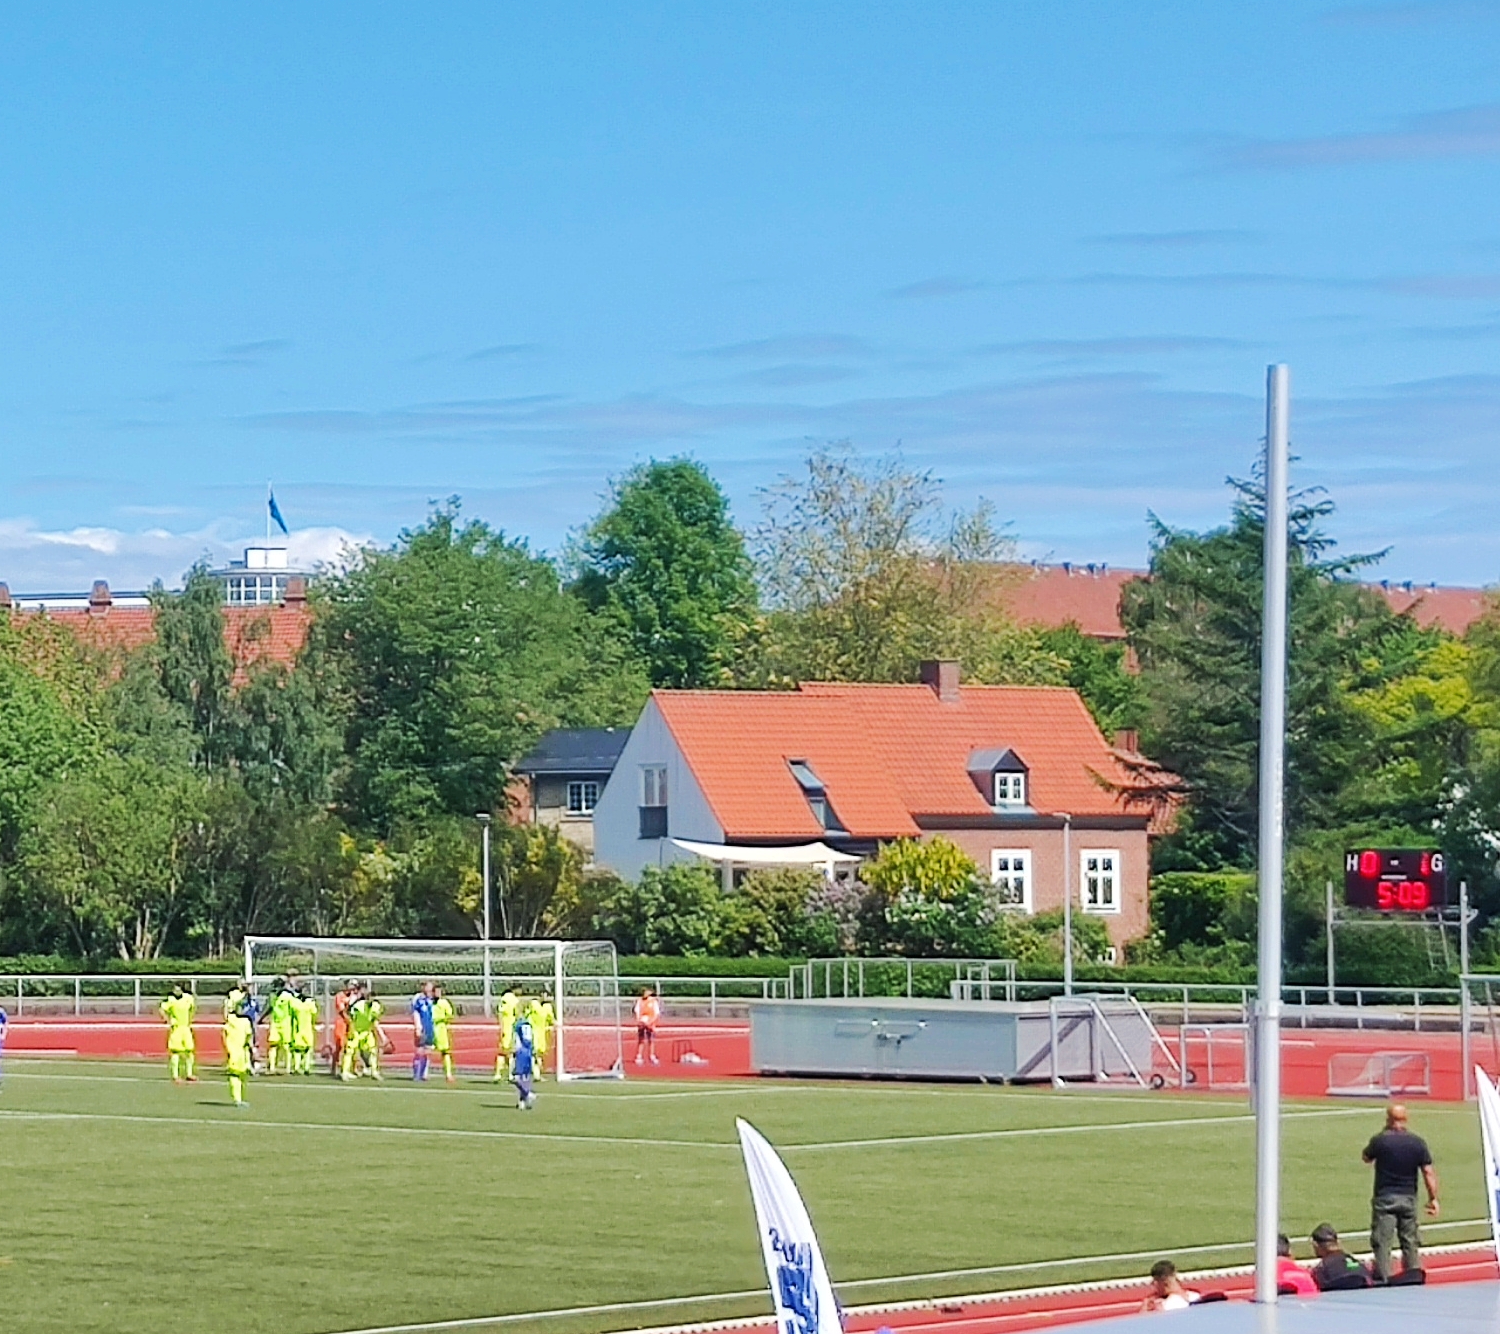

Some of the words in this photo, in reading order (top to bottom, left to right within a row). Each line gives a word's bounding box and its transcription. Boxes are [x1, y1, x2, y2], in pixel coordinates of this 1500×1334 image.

[1346, 853, 1359, 872] H
[1360, 851, 1378, 875] 0
[1431, 853, 1443, 872] G
